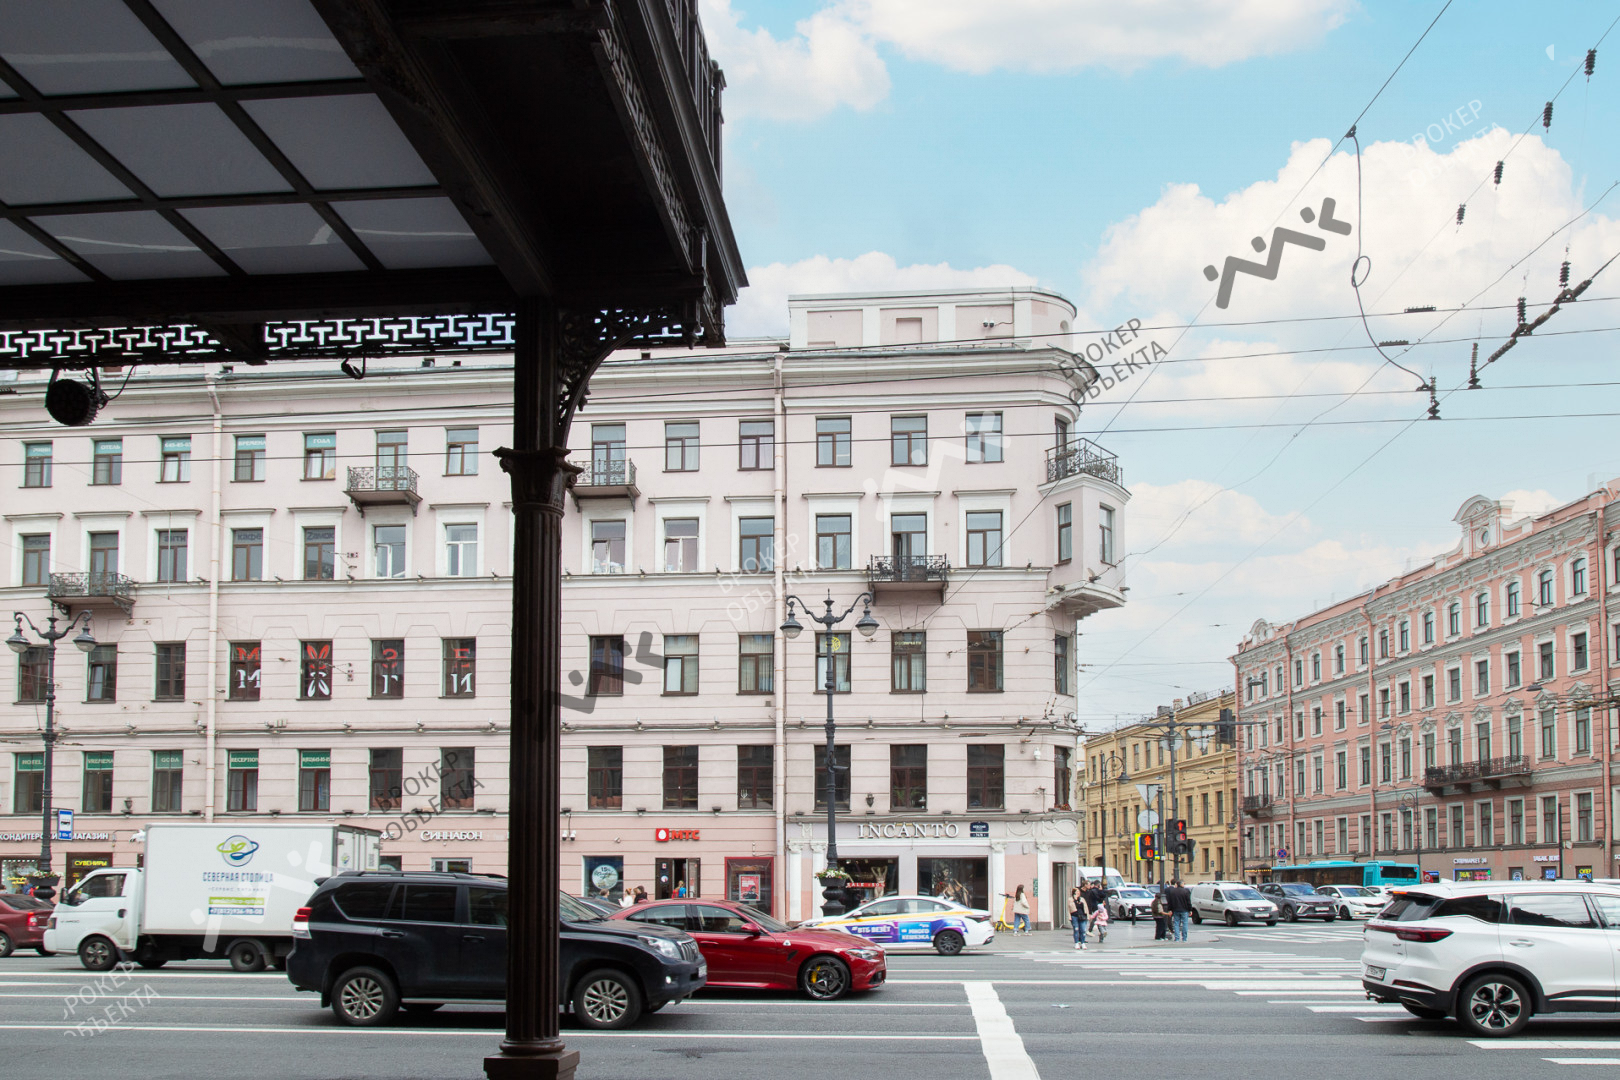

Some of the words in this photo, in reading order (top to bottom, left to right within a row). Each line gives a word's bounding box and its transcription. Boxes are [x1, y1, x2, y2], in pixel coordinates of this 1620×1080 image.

[420, 831, 483, 841] СИННАБОН
[671, 830, 700, 840] МТС
[858, 823, 960, 839] INCANTO
[74, 859, 108, 867] СУВЕНИРЫ
[203, 871, 240, 882] СЕВЕРНАЯ
[241, 872, 275, 883] СТОЛИЦА
